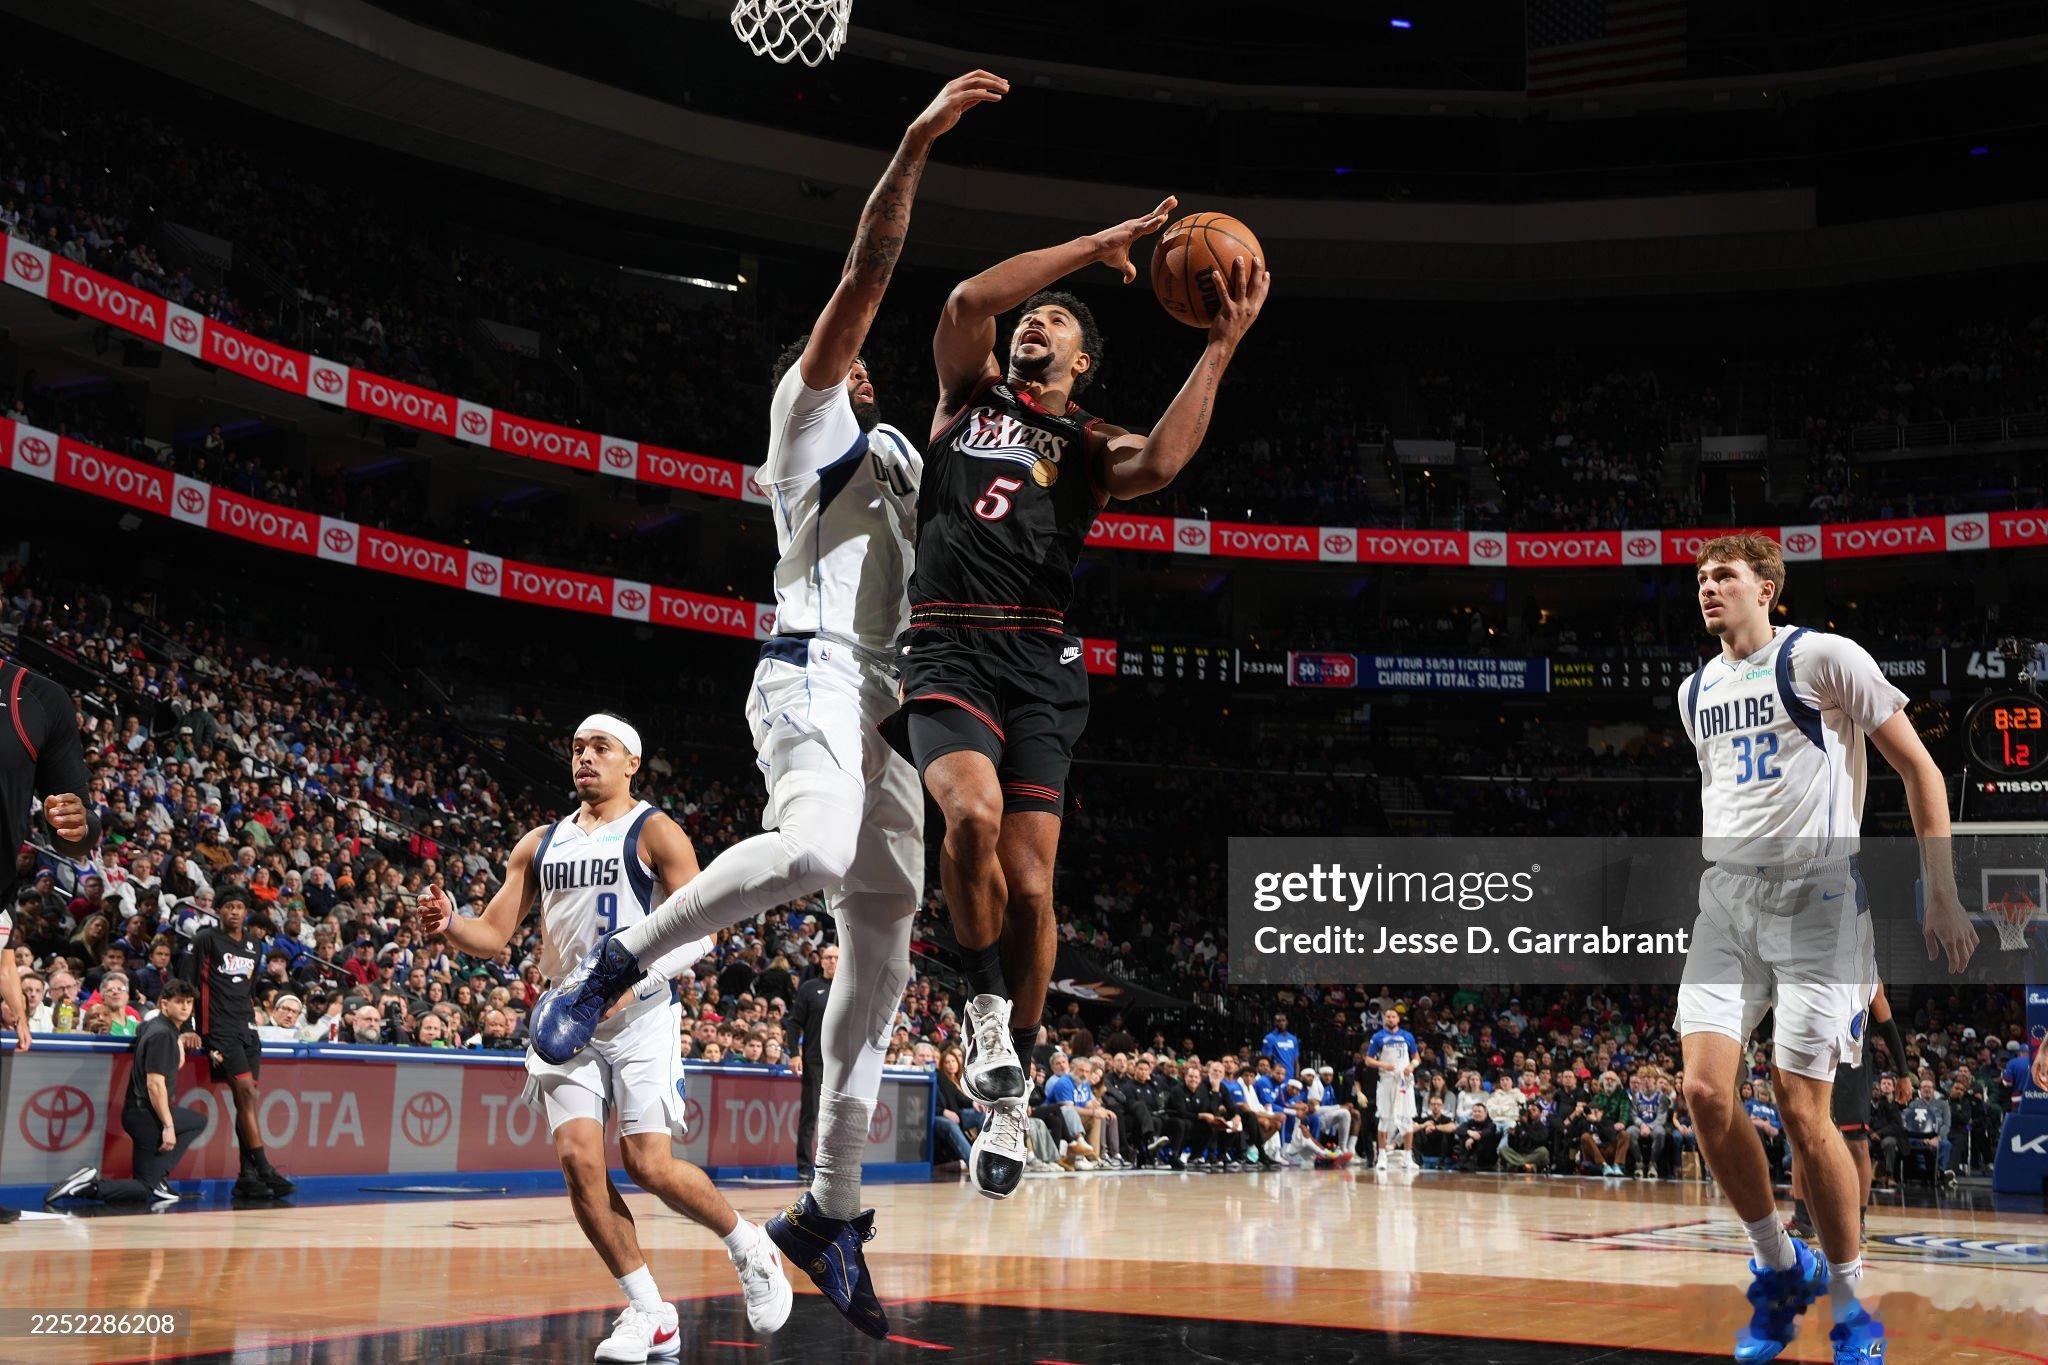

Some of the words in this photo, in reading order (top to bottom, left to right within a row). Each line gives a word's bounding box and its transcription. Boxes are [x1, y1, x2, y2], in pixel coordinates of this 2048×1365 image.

[60, 267, 157, 330] TOYOTA
[211, 330, 299, 383] TOYOTA
[357, 380, 448, 426] TOYOTA
[500, 424, 591, 461] TOYOTA
[646, 454, 734, 488] TOYOTA
[972, 472, 1024, 522] 5
[67, 449, 165, 502] TOYOTA
[218, 499, 309, 543] TOYOTA
[368, 538, 459, 577] TOYOTA
[510, 571, 604, 605] TOYOTA
[659, 596, 747, 628] TOYOTA
[1088, 519, 1166, 543] OYOTA
[1219, 530, 1310, 552] TOYOTA
[1366, 534, 1460, 557] TOYOTA
[1516, 538, 1612, 559] TOYOTA
[1832, 523, 1935, 550] TOYOTA
[1999, 518, 2048, 539] TOY
[1062, 646, 1080, 658] NIKE
[1198, 657, 1206, 668] 0
[1375, 656, 1396, 669] BUY
[1397, 657, 1423, 670] YOUR
[1457, 659, 1497, 672] TICKETS
[1499, 660, 1527, 672] NOW!
[1966, 650, 2006, 679] 45
[1122, 664, 1144, 676] DAL
[1266, 662, 1284, 675] PM
[1378, 670, 1434, 686] CURRENT
[1435, 672, 1476, 688] TOTAL:
[1478, 673, 1525, 689] $10,025
[1601, 662, 1611, 673] 0
[1624, 662, 1630, 673] 1
[1661, 662, 1672, 673] 11
[1745, 667, 1773, 681] chime
[1602, 676, 1612, 687] 11
[1642, 676, 1650, 687] 0
[1661, 676, 1670, 687] 0
[1700, 693, 1774, 739] DALLAS
[1994, 707, 2042, 730] 8:23
[1731, 731, 1782, 785] 32
[543, 857, 619, 891] DALLAS
[598, 892, 617, 936] 9
